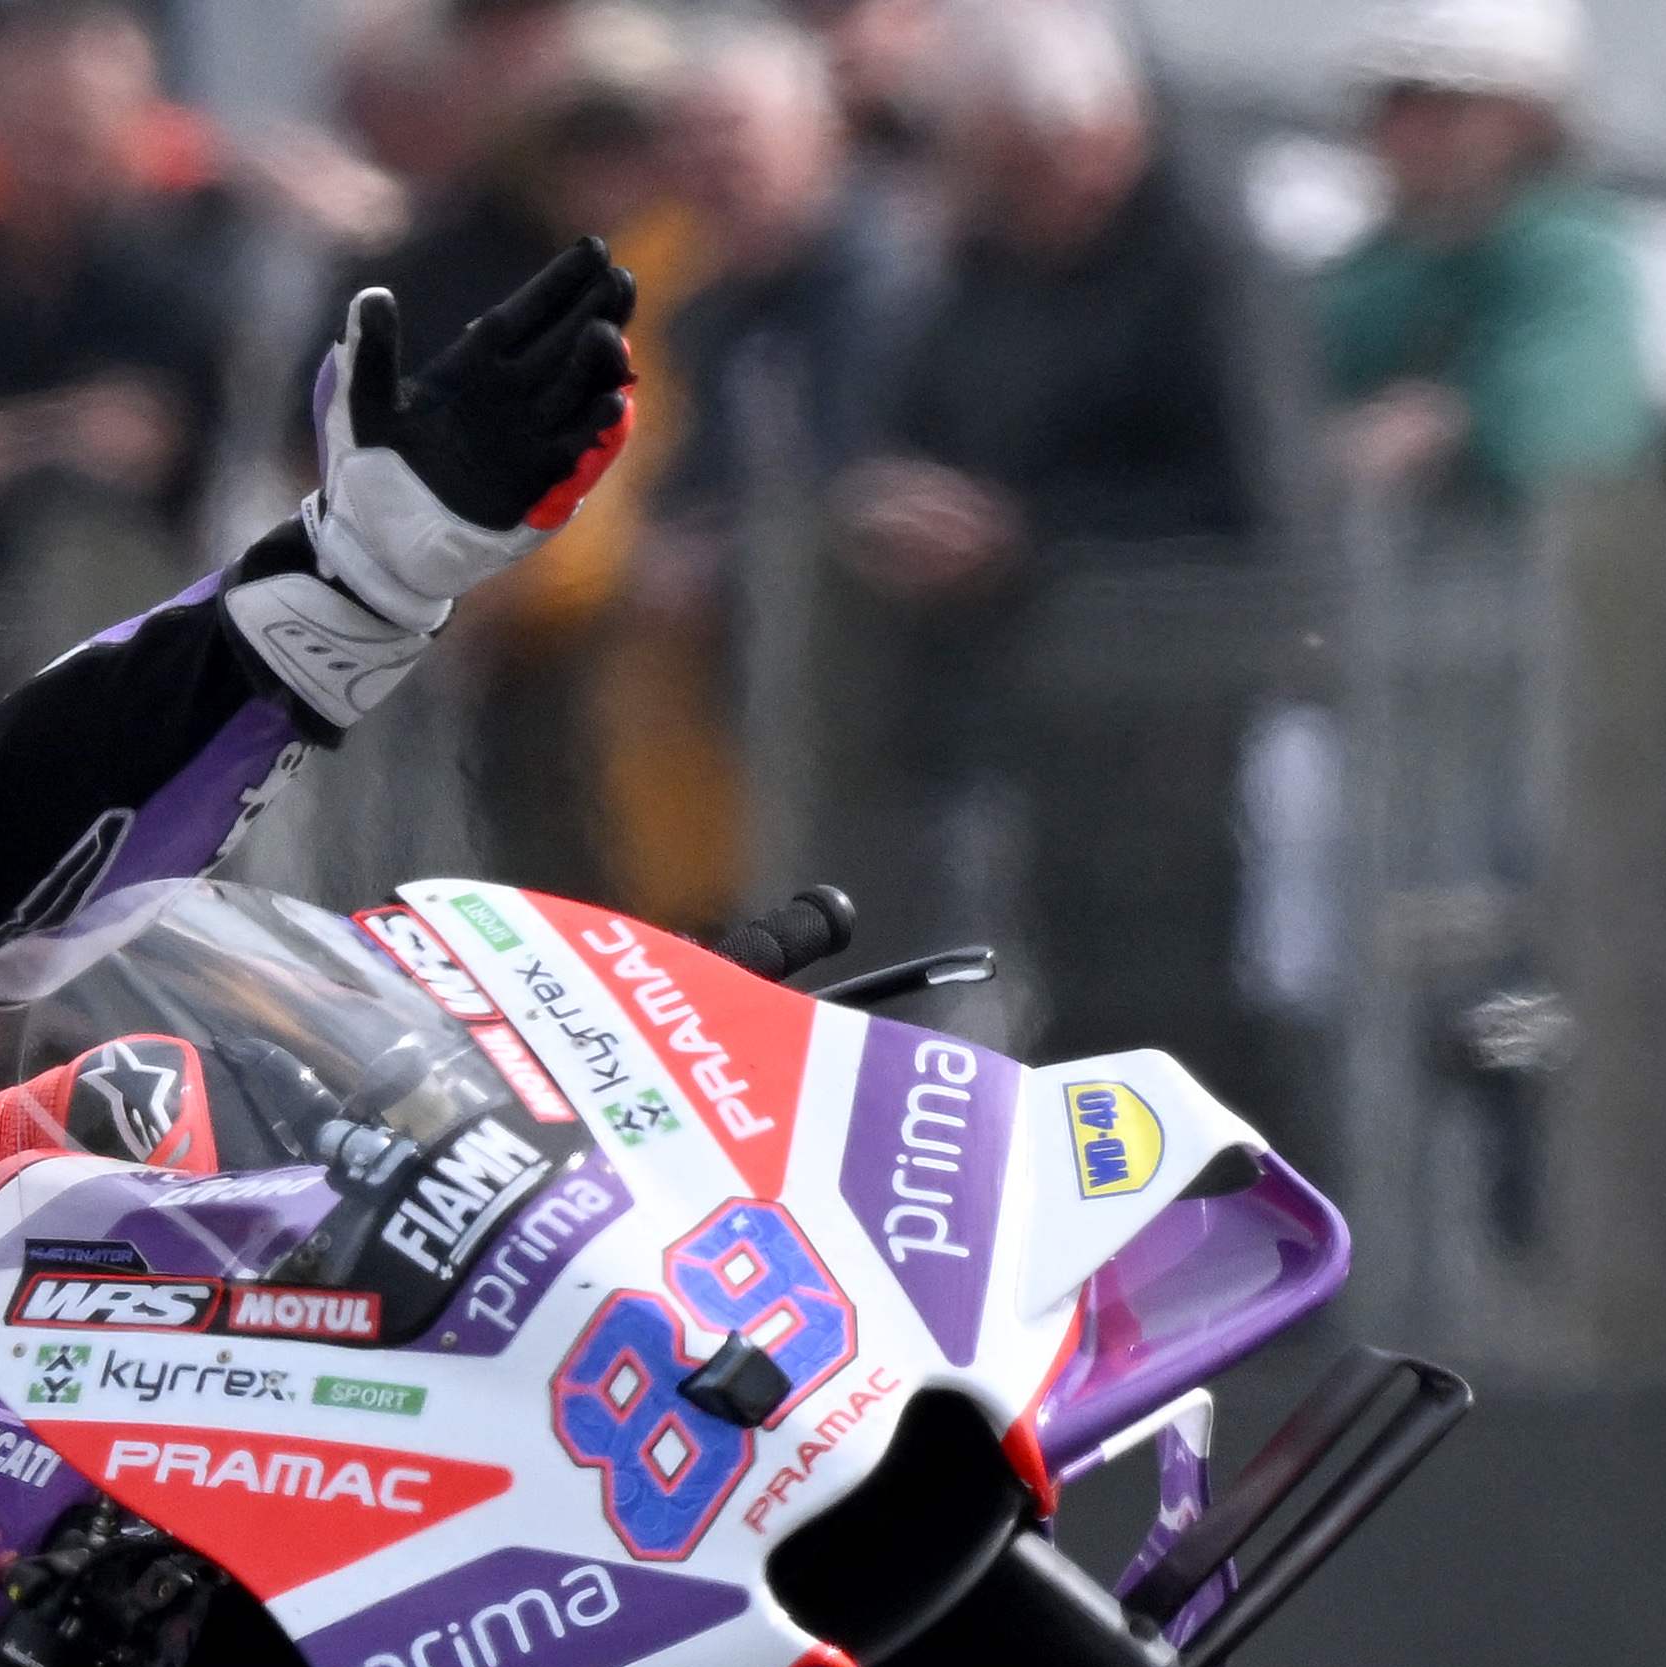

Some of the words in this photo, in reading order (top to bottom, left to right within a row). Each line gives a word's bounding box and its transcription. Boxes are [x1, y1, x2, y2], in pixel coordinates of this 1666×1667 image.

[363, 913, 497, 1017] WRS
[464, 901, 508, 941] SPORT
[482, 1027, 571, 1118] MOTUL
[581, 919, 775, 1142] PRAMAC
[883, 1039, 978, 1263] prima
[1076, 1088, 1130, 1189] WD-40
[382, 1118, 542, 1273] FIAMM
[21, 1279, 211, 1327] WRS
[466, 1177, 613, 1332] prima
[237, 1293, 373, 1334] MOTUL
[328, 1383, 412, 1410] SPORT
[549, 1196, 858, 1562] 89
[105, 1439, 431, 1514] PRAMAC
[742, 1366, 901, 1535] PRAMAC
